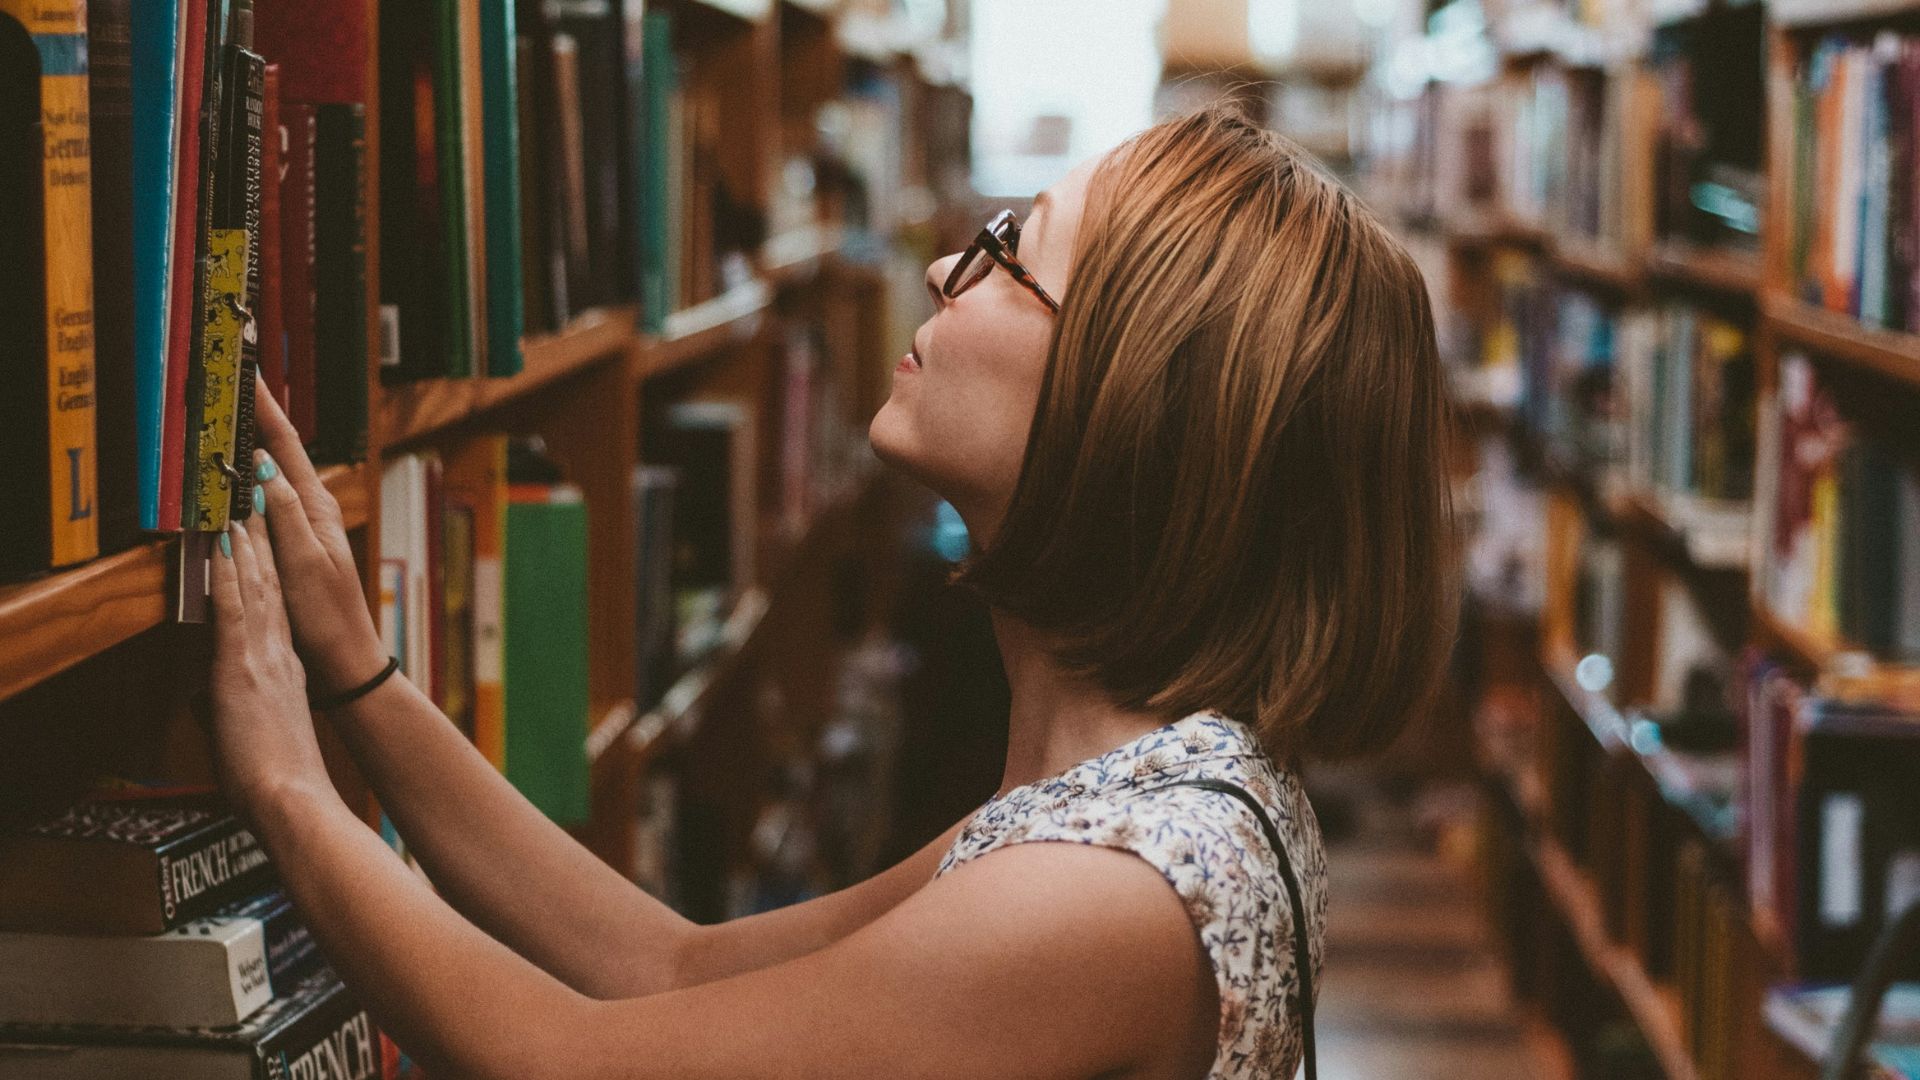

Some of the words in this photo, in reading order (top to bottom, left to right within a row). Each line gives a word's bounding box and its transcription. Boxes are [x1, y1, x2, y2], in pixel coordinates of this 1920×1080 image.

[251, 135, 261, 278] GERMAN-ENGLISH
[66, 447, 91, 522] L
[172, 839, 231, 904] FRENCH
[289, 1010, 375, 1080] ENCH
